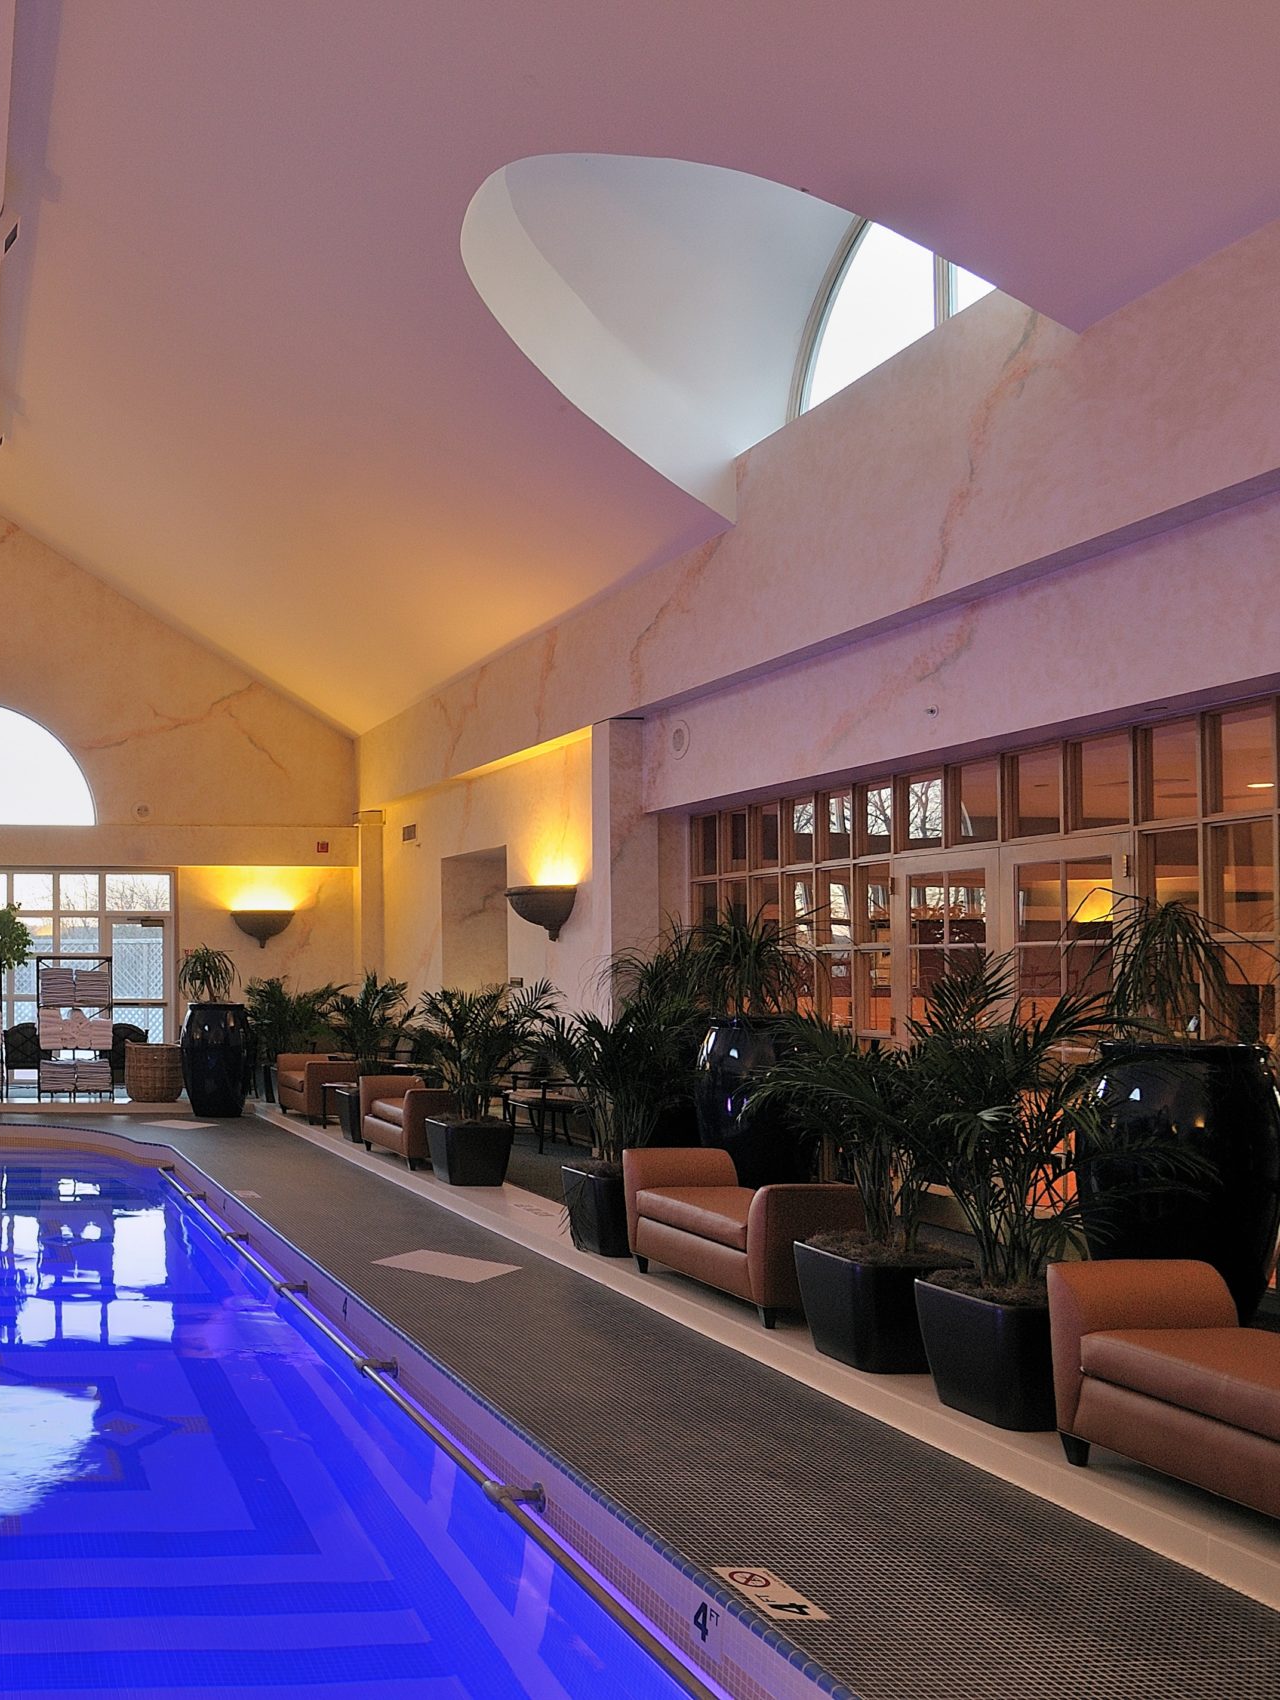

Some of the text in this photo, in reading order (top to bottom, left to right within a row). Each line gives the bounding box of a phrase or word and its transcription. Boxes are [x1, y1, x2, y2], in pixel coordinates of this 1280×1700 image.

[754, 1593, 810, 1616] 4 FT
[694, 1601, 720, 1643] 4 FT
